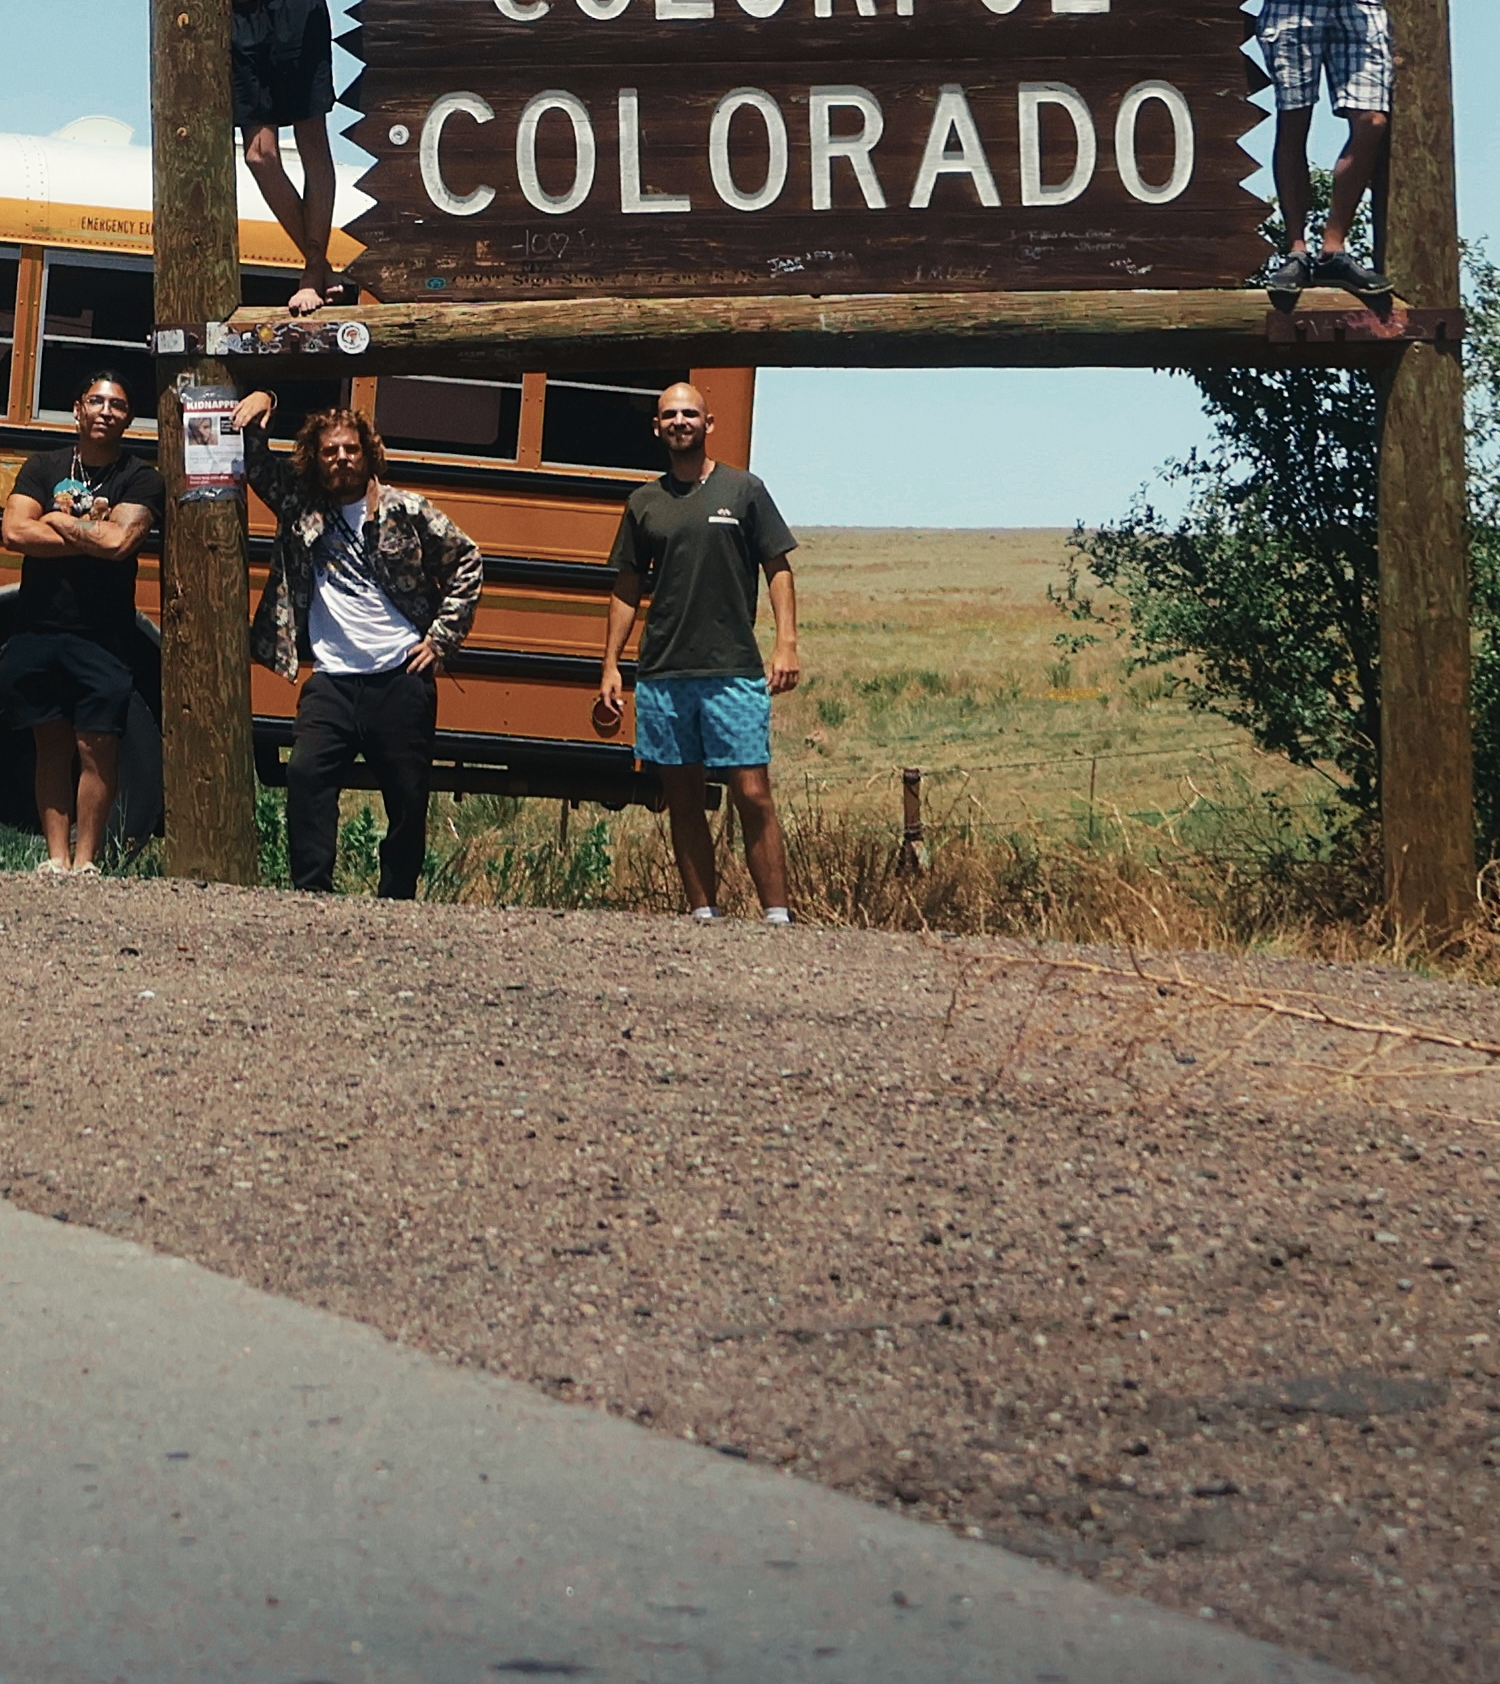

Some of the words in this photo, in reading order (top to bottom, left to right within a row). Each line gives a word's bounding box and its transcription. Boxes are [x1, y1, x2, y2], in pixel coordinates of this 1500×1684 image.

[418, 79, 1195, 217] COLORADO
[80, 215, 136, 235] EMERGENCY
[139, 221, 154, 236] EXI
